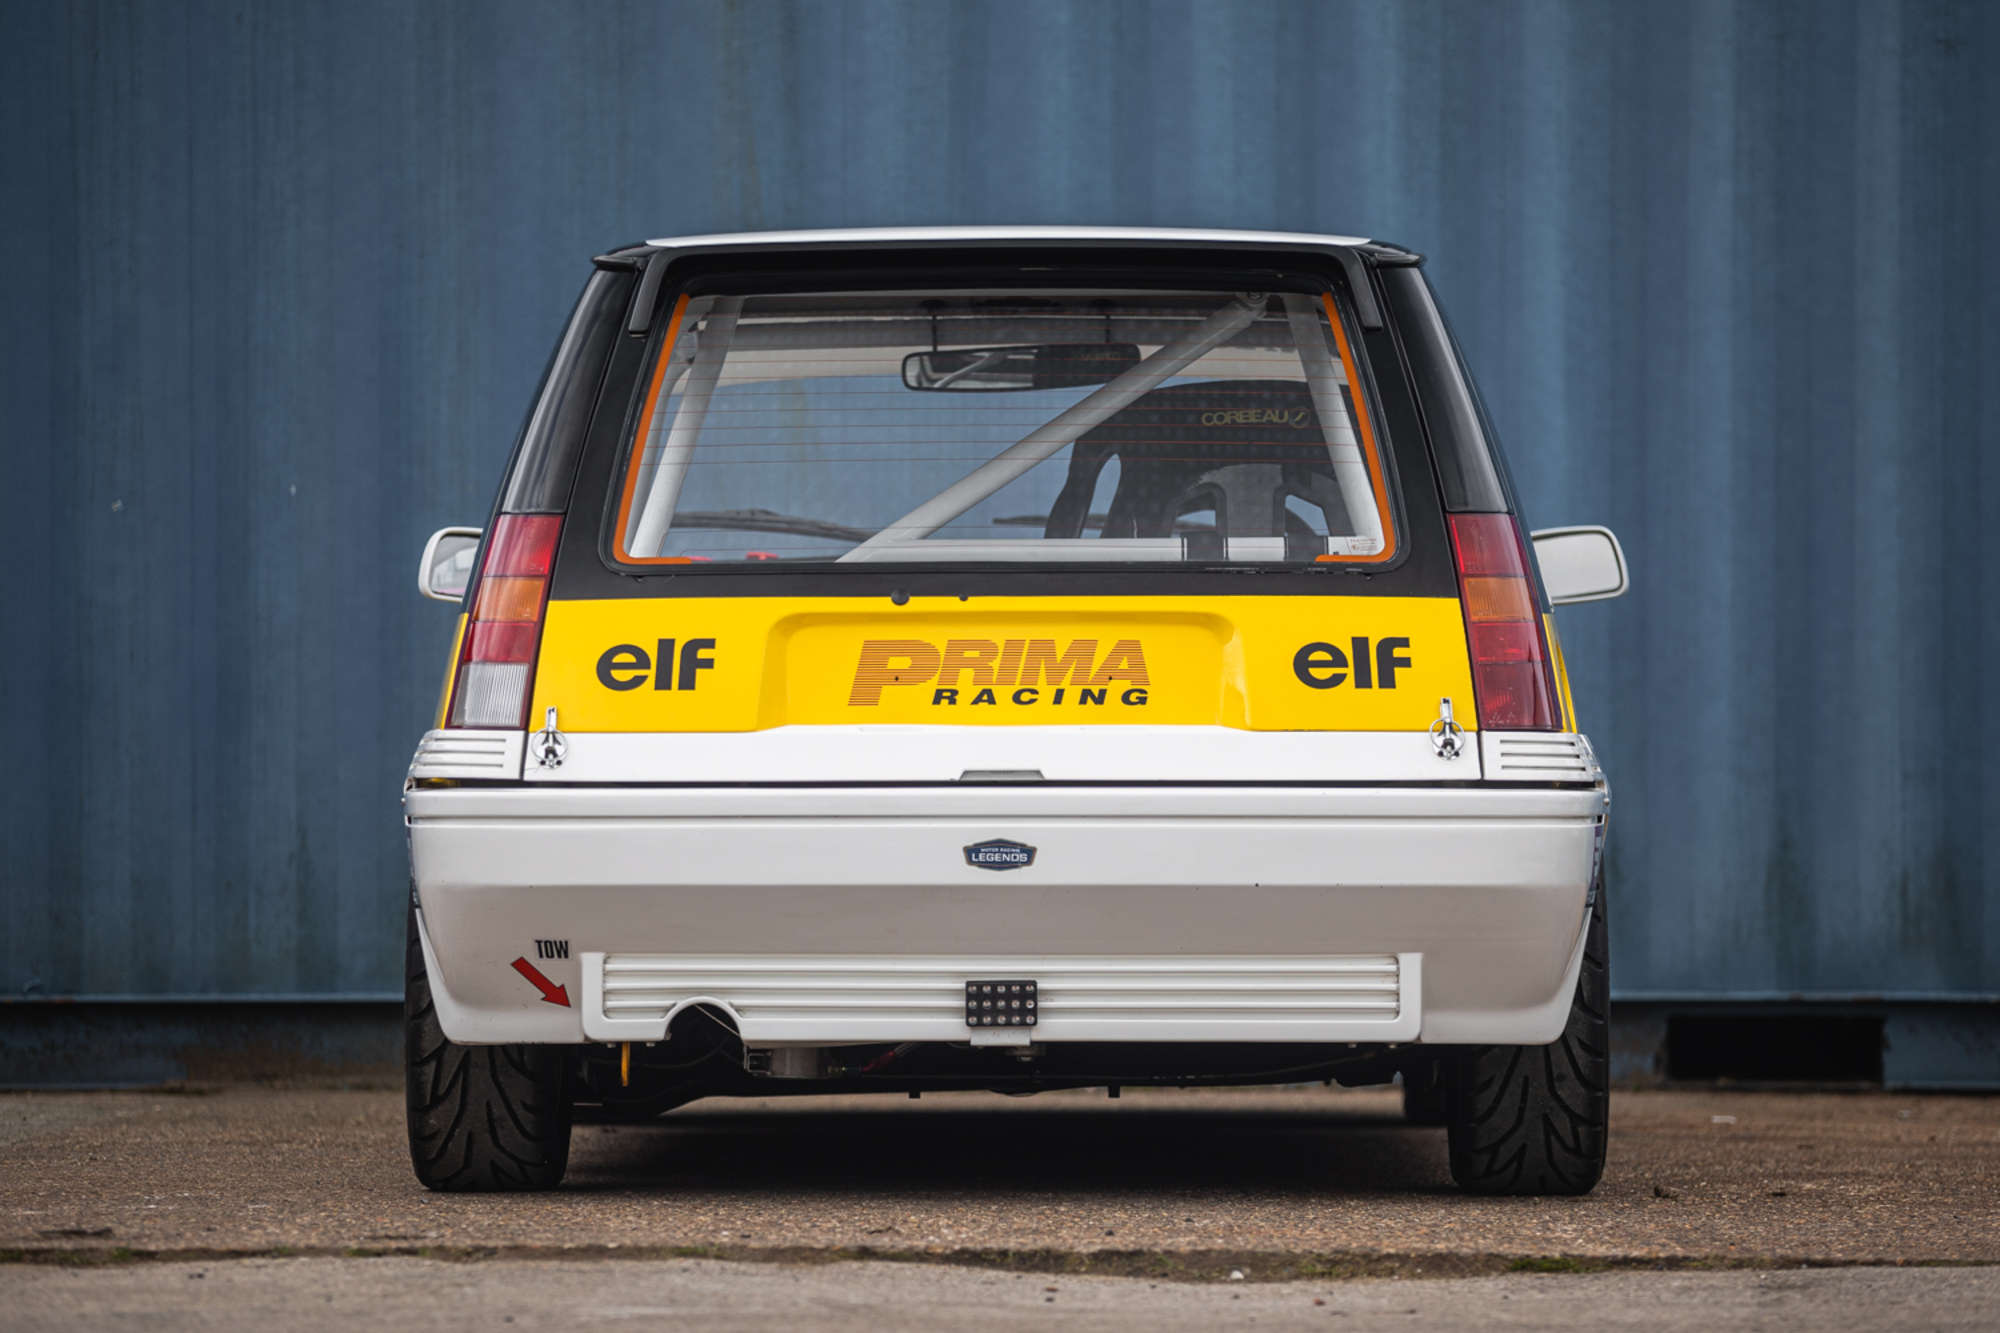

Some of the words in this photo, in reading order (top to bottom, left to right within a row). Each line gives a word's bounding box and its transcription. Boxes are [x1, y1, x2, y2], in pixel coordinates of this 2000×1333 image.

[1201, 409, 1289, 426] CORBEAU
[596, 638, 716, 692] elf
[848, 639, 1151, 706] PRIMA
[1293, 636, 1412, 690] elf
[931, 688, 1149, 706] RACING
[971, 853, 1028, 862] LEGENDS
[535, 939, 569, 959] TOW
